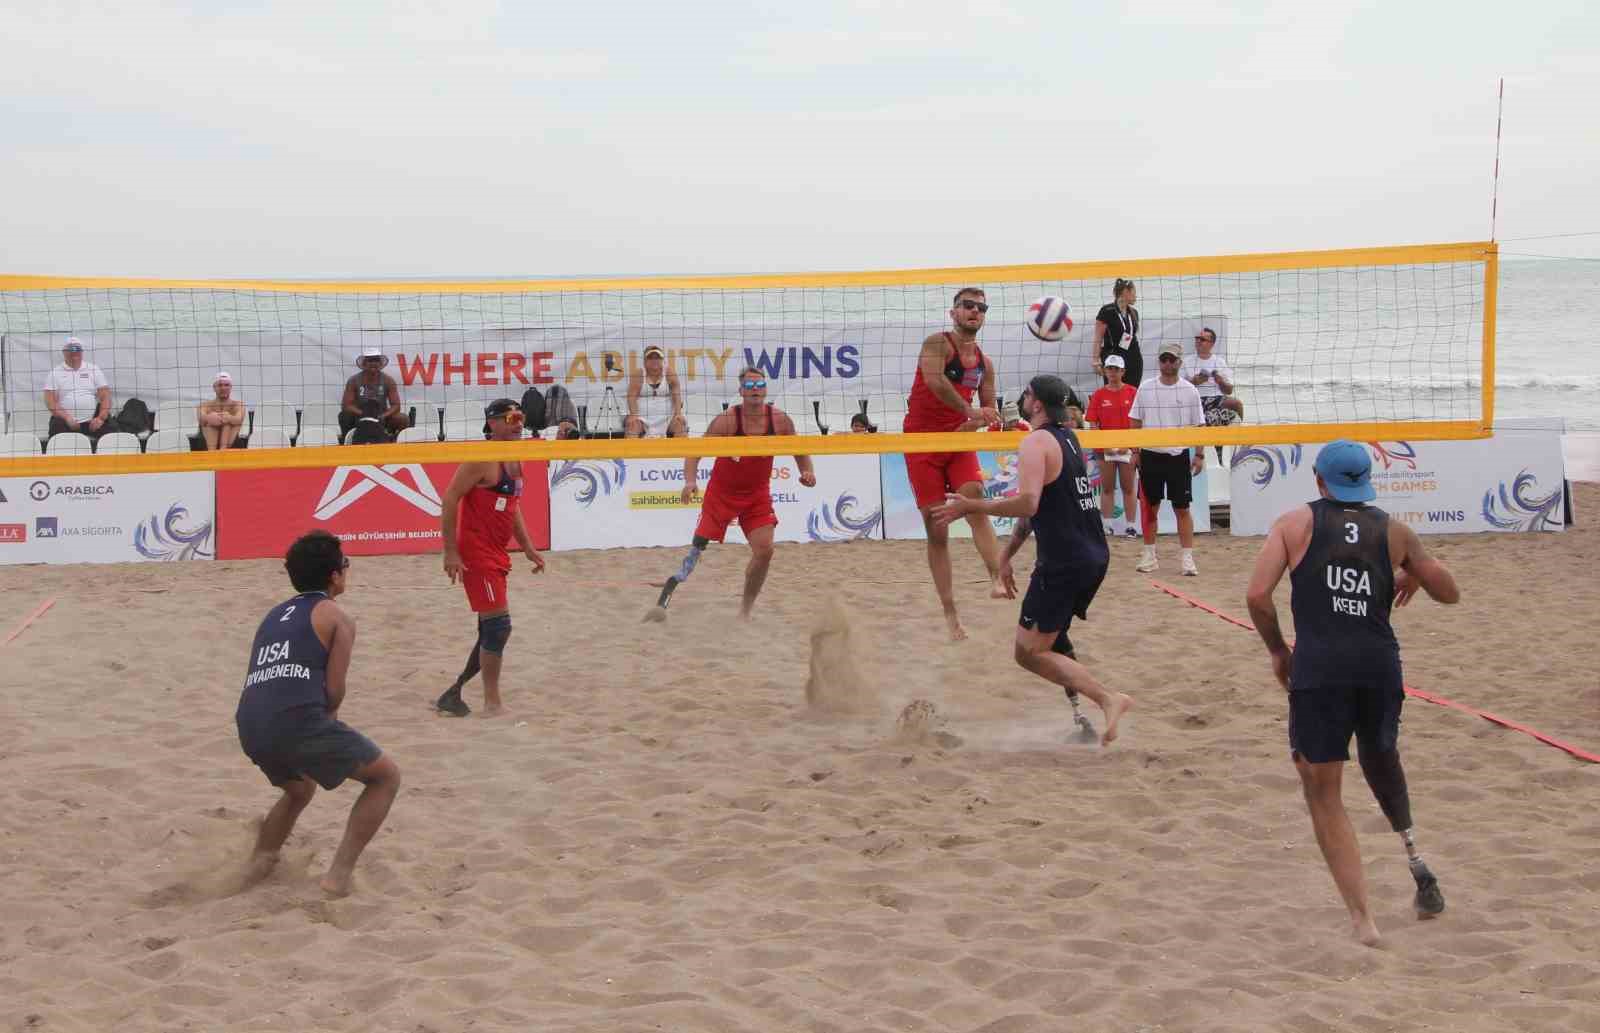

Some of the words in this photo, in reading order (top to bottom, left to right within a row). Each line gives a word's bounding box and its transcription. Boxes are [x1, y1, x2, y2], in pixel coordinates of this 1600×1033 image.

[396, 351, 554, 386] WHERE
[564, 347, 735, 384] ABIITY
[743, 344, 861, 380] WINS
[640, 469, 659, 481] LC
[54, 485, 115, 496] ARABICA
[1074, 476, 1092, 495] US
[1391, 480, 1438, 493] GAMES
[631, 495, 704, 506] sahibindeco
[769, 493, 801, 503] CELL
[1427, 510, 1465, 523] WINS
[61, 526, 80, 537] AXA
[1344, 522, 1360, 544] 3
[1326, 565, 1372, 596] USA
[279, 605, 297, 622] 2
[1332, 595, 1368, 617] KEEN
[256, 639, 290, 666] USA
